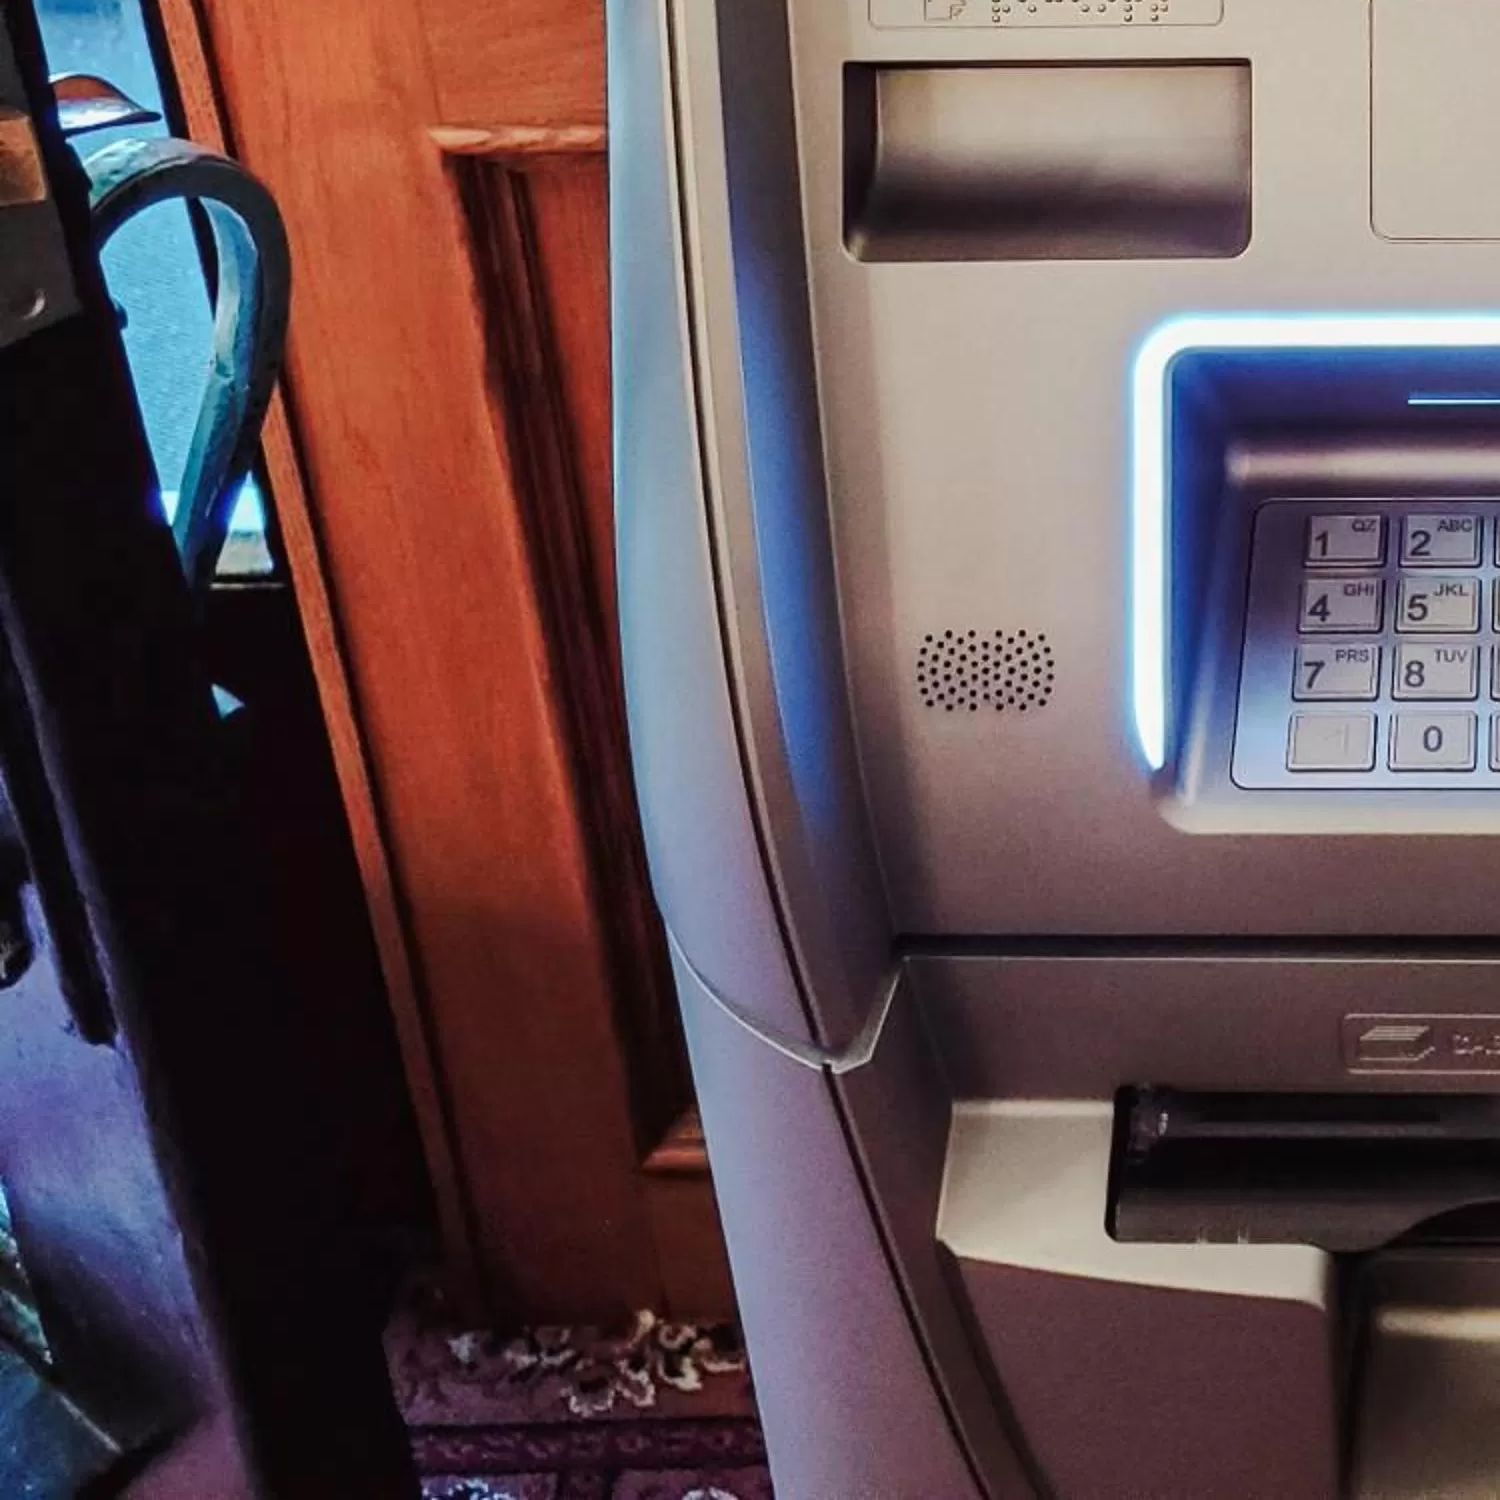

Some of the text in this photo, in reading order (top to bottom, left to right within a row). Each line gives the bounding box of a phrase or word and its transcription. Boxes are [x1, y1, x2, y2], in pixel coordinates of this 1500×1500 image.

[1315, 519, 1377, 557] 1 QZ
[1410, 519, 1472, 557] 2 ABC
[1308, 583, 1374, 622] 4 GHI
[1407, 583, 1468, 621] 5 JKL
[1303, 650, 1370, 689] 7 PRS
[1404, 650, 1468, 688] 8 TUV
[1423, 726, 1443, 753] 0
